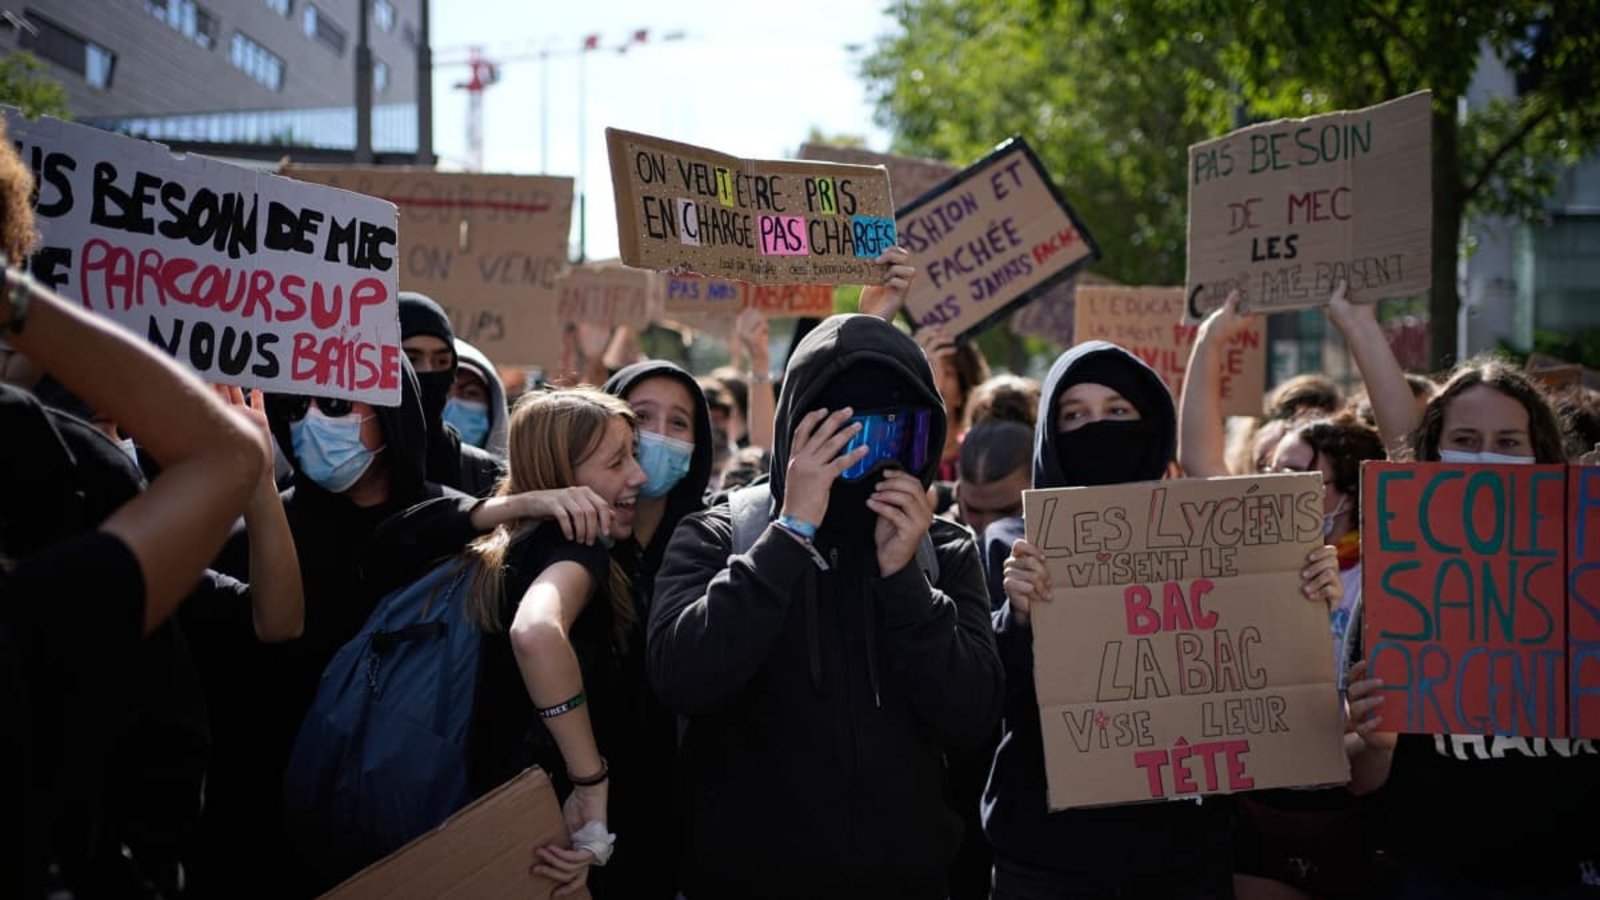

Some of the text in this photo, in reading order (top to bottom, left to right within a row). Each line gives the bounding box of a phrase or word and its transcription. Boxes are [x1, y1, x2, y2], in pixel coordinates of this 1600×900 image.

[636, 151, 666, 185] ON
[676, 160, 731, 203] VEUT
[804, 175, 858, 216] PRIS
[1195, 121, 1372, 184] PAS BESOIN
[90, 162, 258, 260] BESOIN
[263, 201, 325, 255] DE
[324, 216, 397, 272] MEC
[643, 196, 677, 240] EN
[681, 201, 755, 250] CHARGE
[759, 216, 803, 252] PAS
[896, 160, 1025, 253] ASHION ET
[1227, 187, 1353, 236] DE MEC
[969, 253, 1034, 303] JAMAIS
[1252, 234, 1299, 262] LES
[80, 238, 389, 330] PARCOURSUP
[148, 314, 280, 378] NOUS
[1034, 484, 1325, 559] LES LYCÉENS
[1376, 470, 1567, 557] ECOLE
[1199, 547, 1239, 578] LE
[1122, 578, 1220, 636] BAC
[1379, 557, 1555, 645] SANS
[1095, 625, 1268, 702] LA BAC
[1366, 642, 1566, 736] ARGENT
[1200, 695, 1290, 738] LEUR
[1133, 735, 1256, 798] TÊTE
